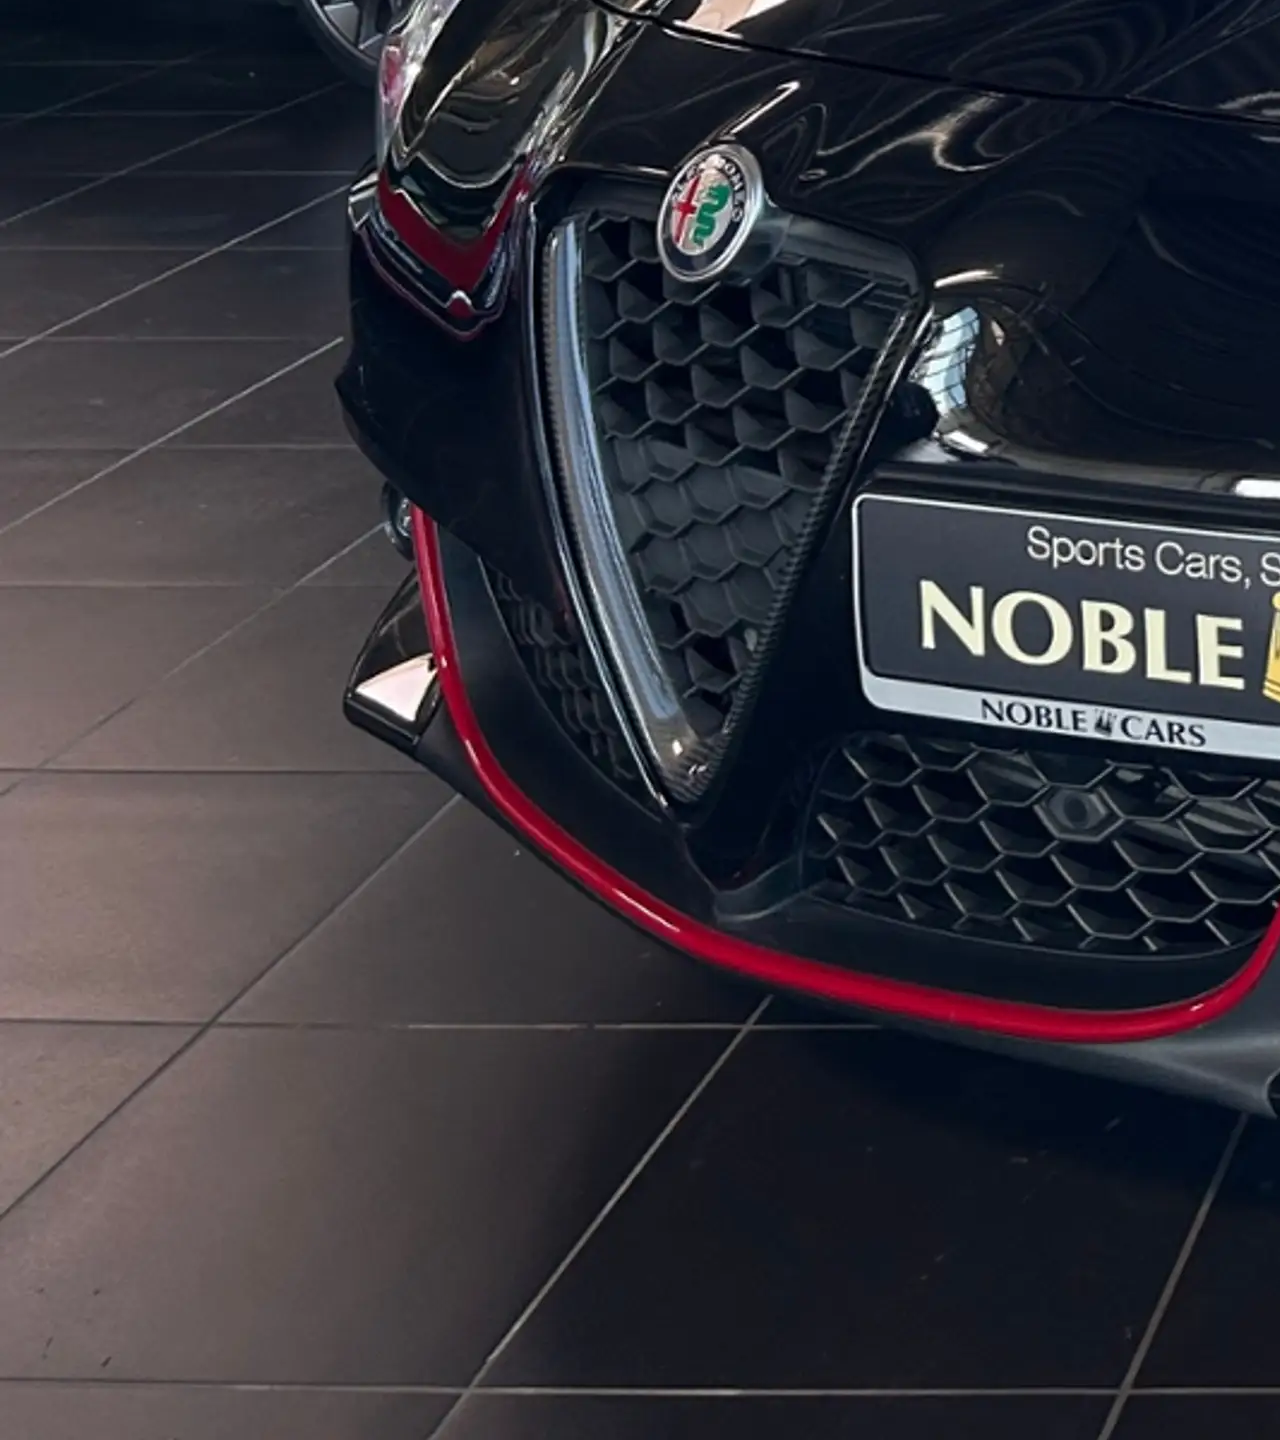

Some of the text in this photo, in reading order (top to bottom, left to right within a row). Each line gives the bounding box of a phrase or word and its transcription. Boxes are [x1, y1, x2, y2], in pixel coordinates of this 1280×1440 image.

[1026, 525, 1146, 571] Sports
[1154, 541, 1252, 589] Cars,
[919, 578, 1246, 691] NOBLE
[980, 697, 1207, 748] NOBLE CARS
